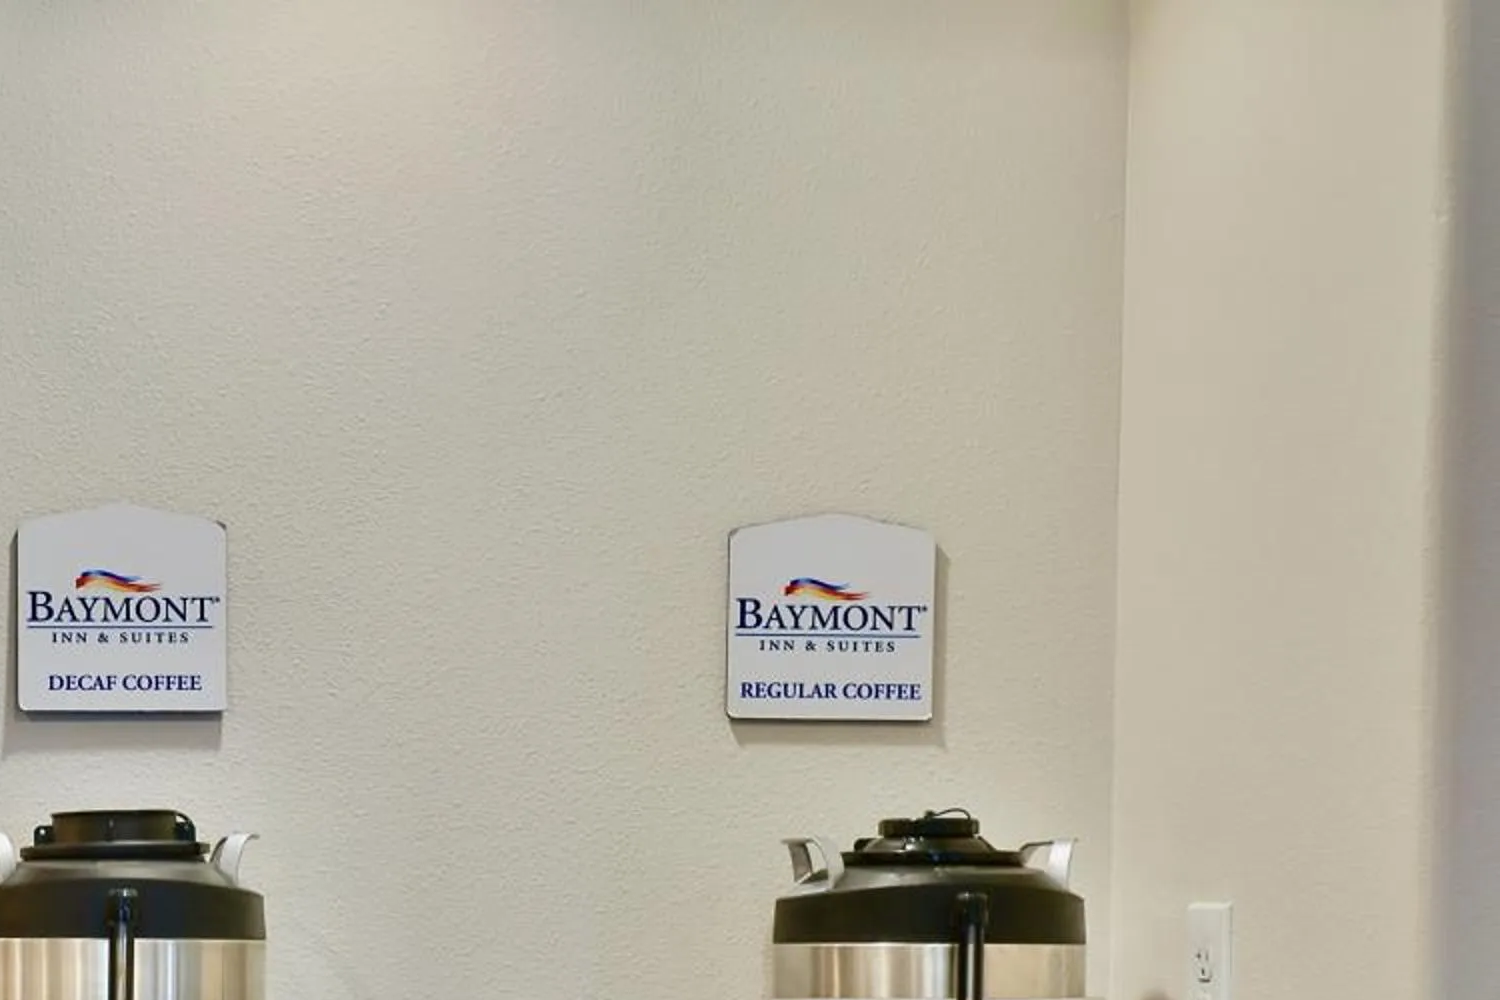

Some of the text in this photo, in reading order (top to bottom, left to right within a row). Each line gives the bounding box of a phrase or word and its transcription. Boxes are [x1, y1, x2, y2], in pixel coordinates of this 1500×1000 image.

[27, 591, 213, 623] BAYMONT
[736, 598, 921, 632] BAYMONT
[52, 632, 189, 643] INN & SUITES
[759, 640, 895, 653] INN & SUITES
[48, 674, 202, 691] DECAF COFFEE
[740, 682, 922, 700] REGULAR COFFEE
